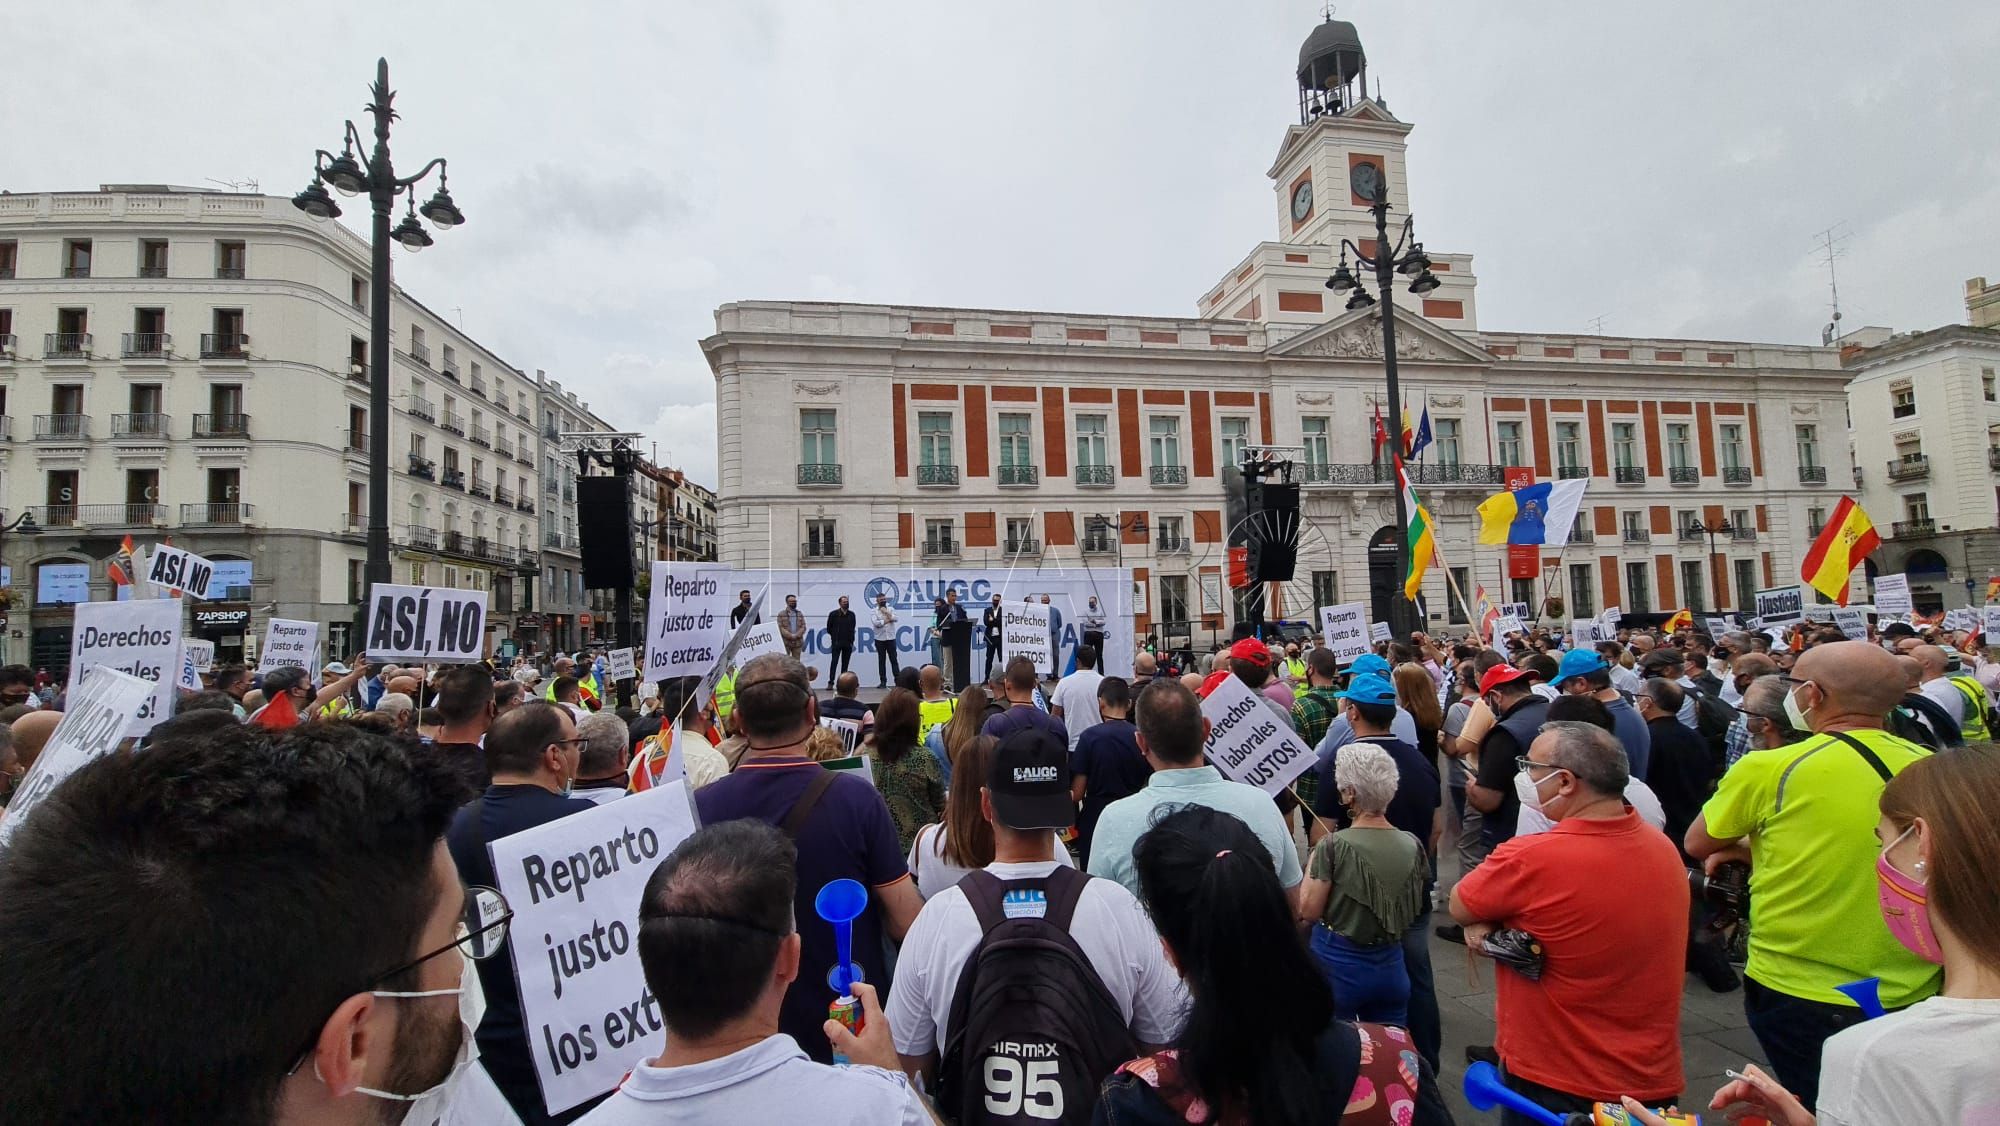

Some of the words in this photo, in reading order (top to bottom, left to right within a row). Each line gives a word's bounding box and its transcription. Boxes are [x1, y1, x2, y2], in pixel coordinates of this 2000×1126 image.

[150, 553, 189, 590] ASÍ,
[188, 562, 212, 596] NO
[665, 574, 717, 603] Reparto
[903, 579, 992, 602] AUGC
[1516, 605, 1527, 617] NO
[1758, 591, 1802, 617] ¡Justicia!
[196, 611, 248, 621] ZAPSHOP
[369, 589, 432, 656] ASÍ,
[437, 601, 482, 653] NO
[660, 611, 694, 638] justo
[698, 609, 713, 630] de
[1004, 612, 1047, 628] ¡Derechos
[1327, 611, 1357, 625] Reparto
[78, 624, 172, 656] ¡Derechos
[273, 623, 307, 636] Reparto
[1007, 631, 1045, 646] laborales
[1331, 629, 1349, 644] justo
[1350, 626, 1361, 638] de
[270, 639, 291, 652] justo
[293, 639, 304, 651] de
[651, 647, 668, 668] los
[671, 646, 714, 665] extras.
[1343, 645, 1368, 657] extras.
[263, 655, 275, 665] los
[277, 656, 305, 668] extras.
[1221, 721, 1277, 769] laborales
[1023, 766, 1057, 778] AUGC
[1244, 739, 1302, 788] JUSTOS!
[522, 826, 659, 904] Reparto
[544, 918, 630, 1000] justo
[543, 1023, 598, 1076] los
[604, 987, 663, 1048] ext
[984, 1056, 1064, 1119] 95
